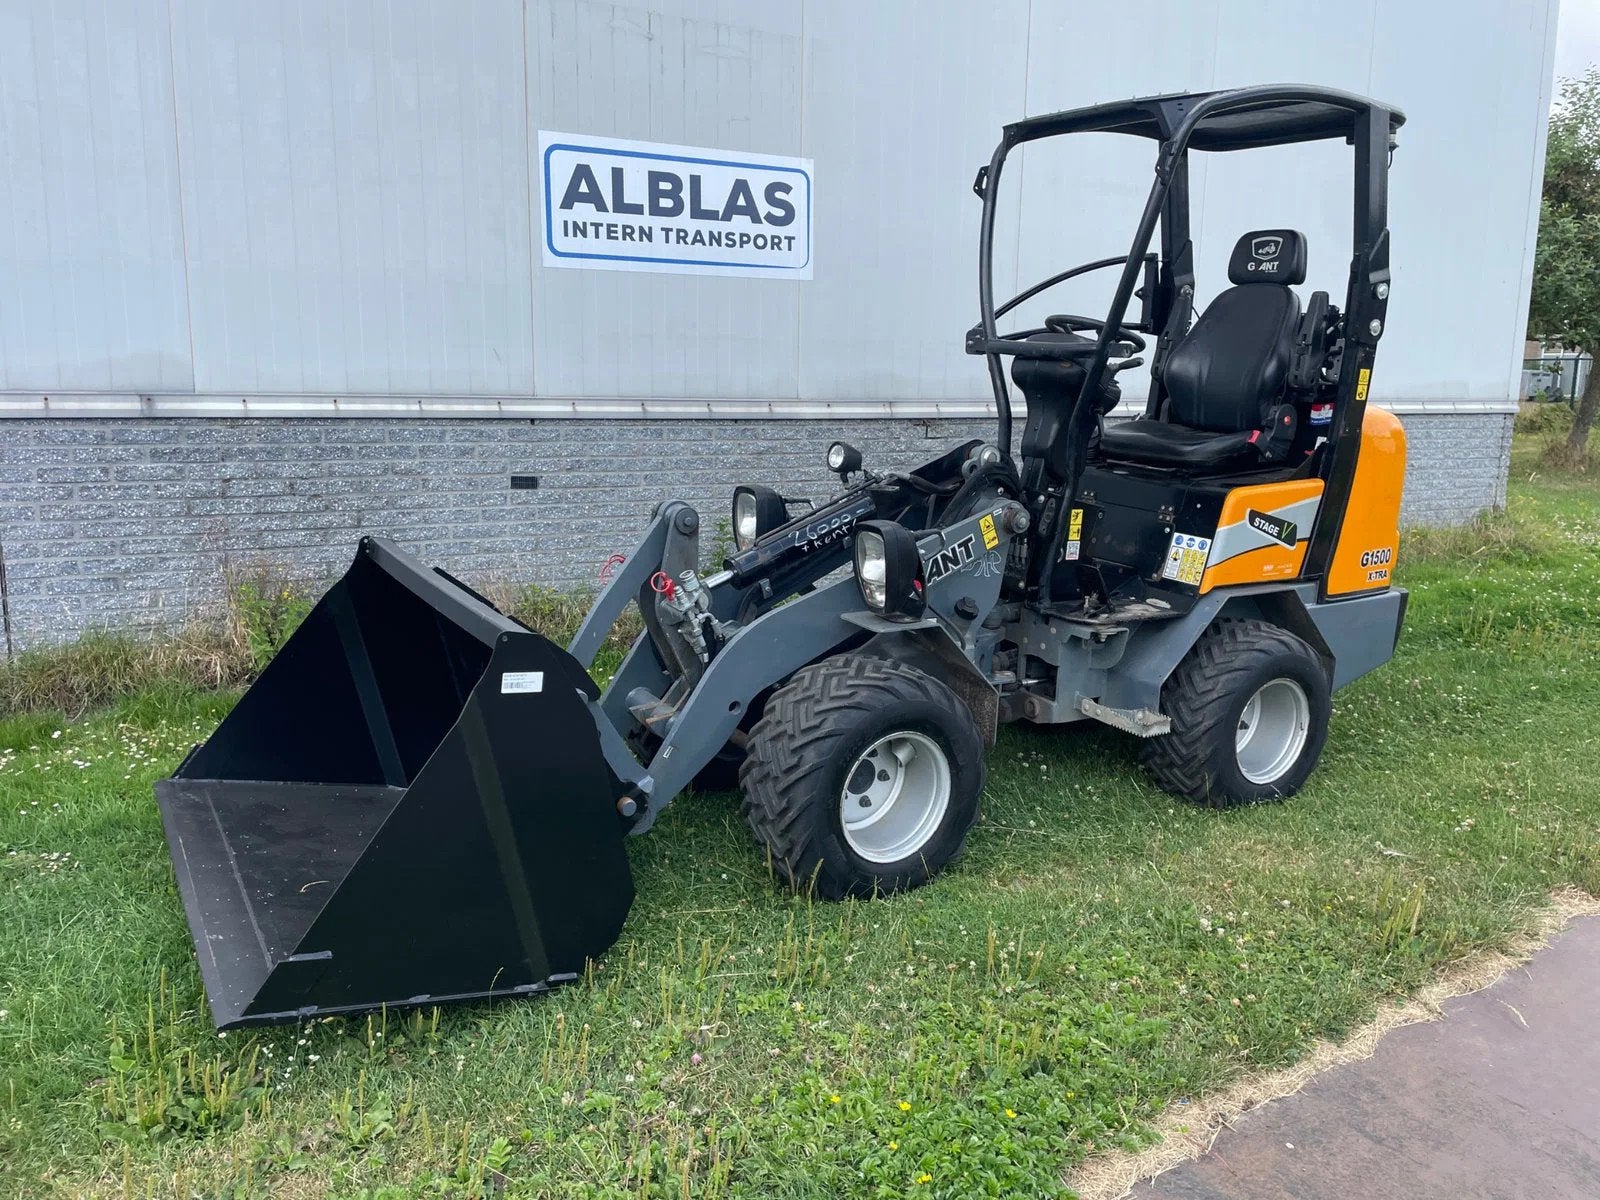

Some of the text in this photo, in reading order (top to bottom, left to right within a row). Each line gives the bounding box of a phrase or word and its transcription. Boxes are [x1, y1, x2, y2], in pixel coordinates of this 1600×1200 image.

[559, 163, 796, 227] ALBLAS
[563, 220, 796, 251] INTERN TRANSPORT
[1247, 261, 1279, 271] GANT
[1253, 517, 1296, 540] STAGE V
[926, 533, 976, 586] ANT
[1360, 547, 1391, 568] G1500
[1367, 569, 1388, 581] X-TRA
